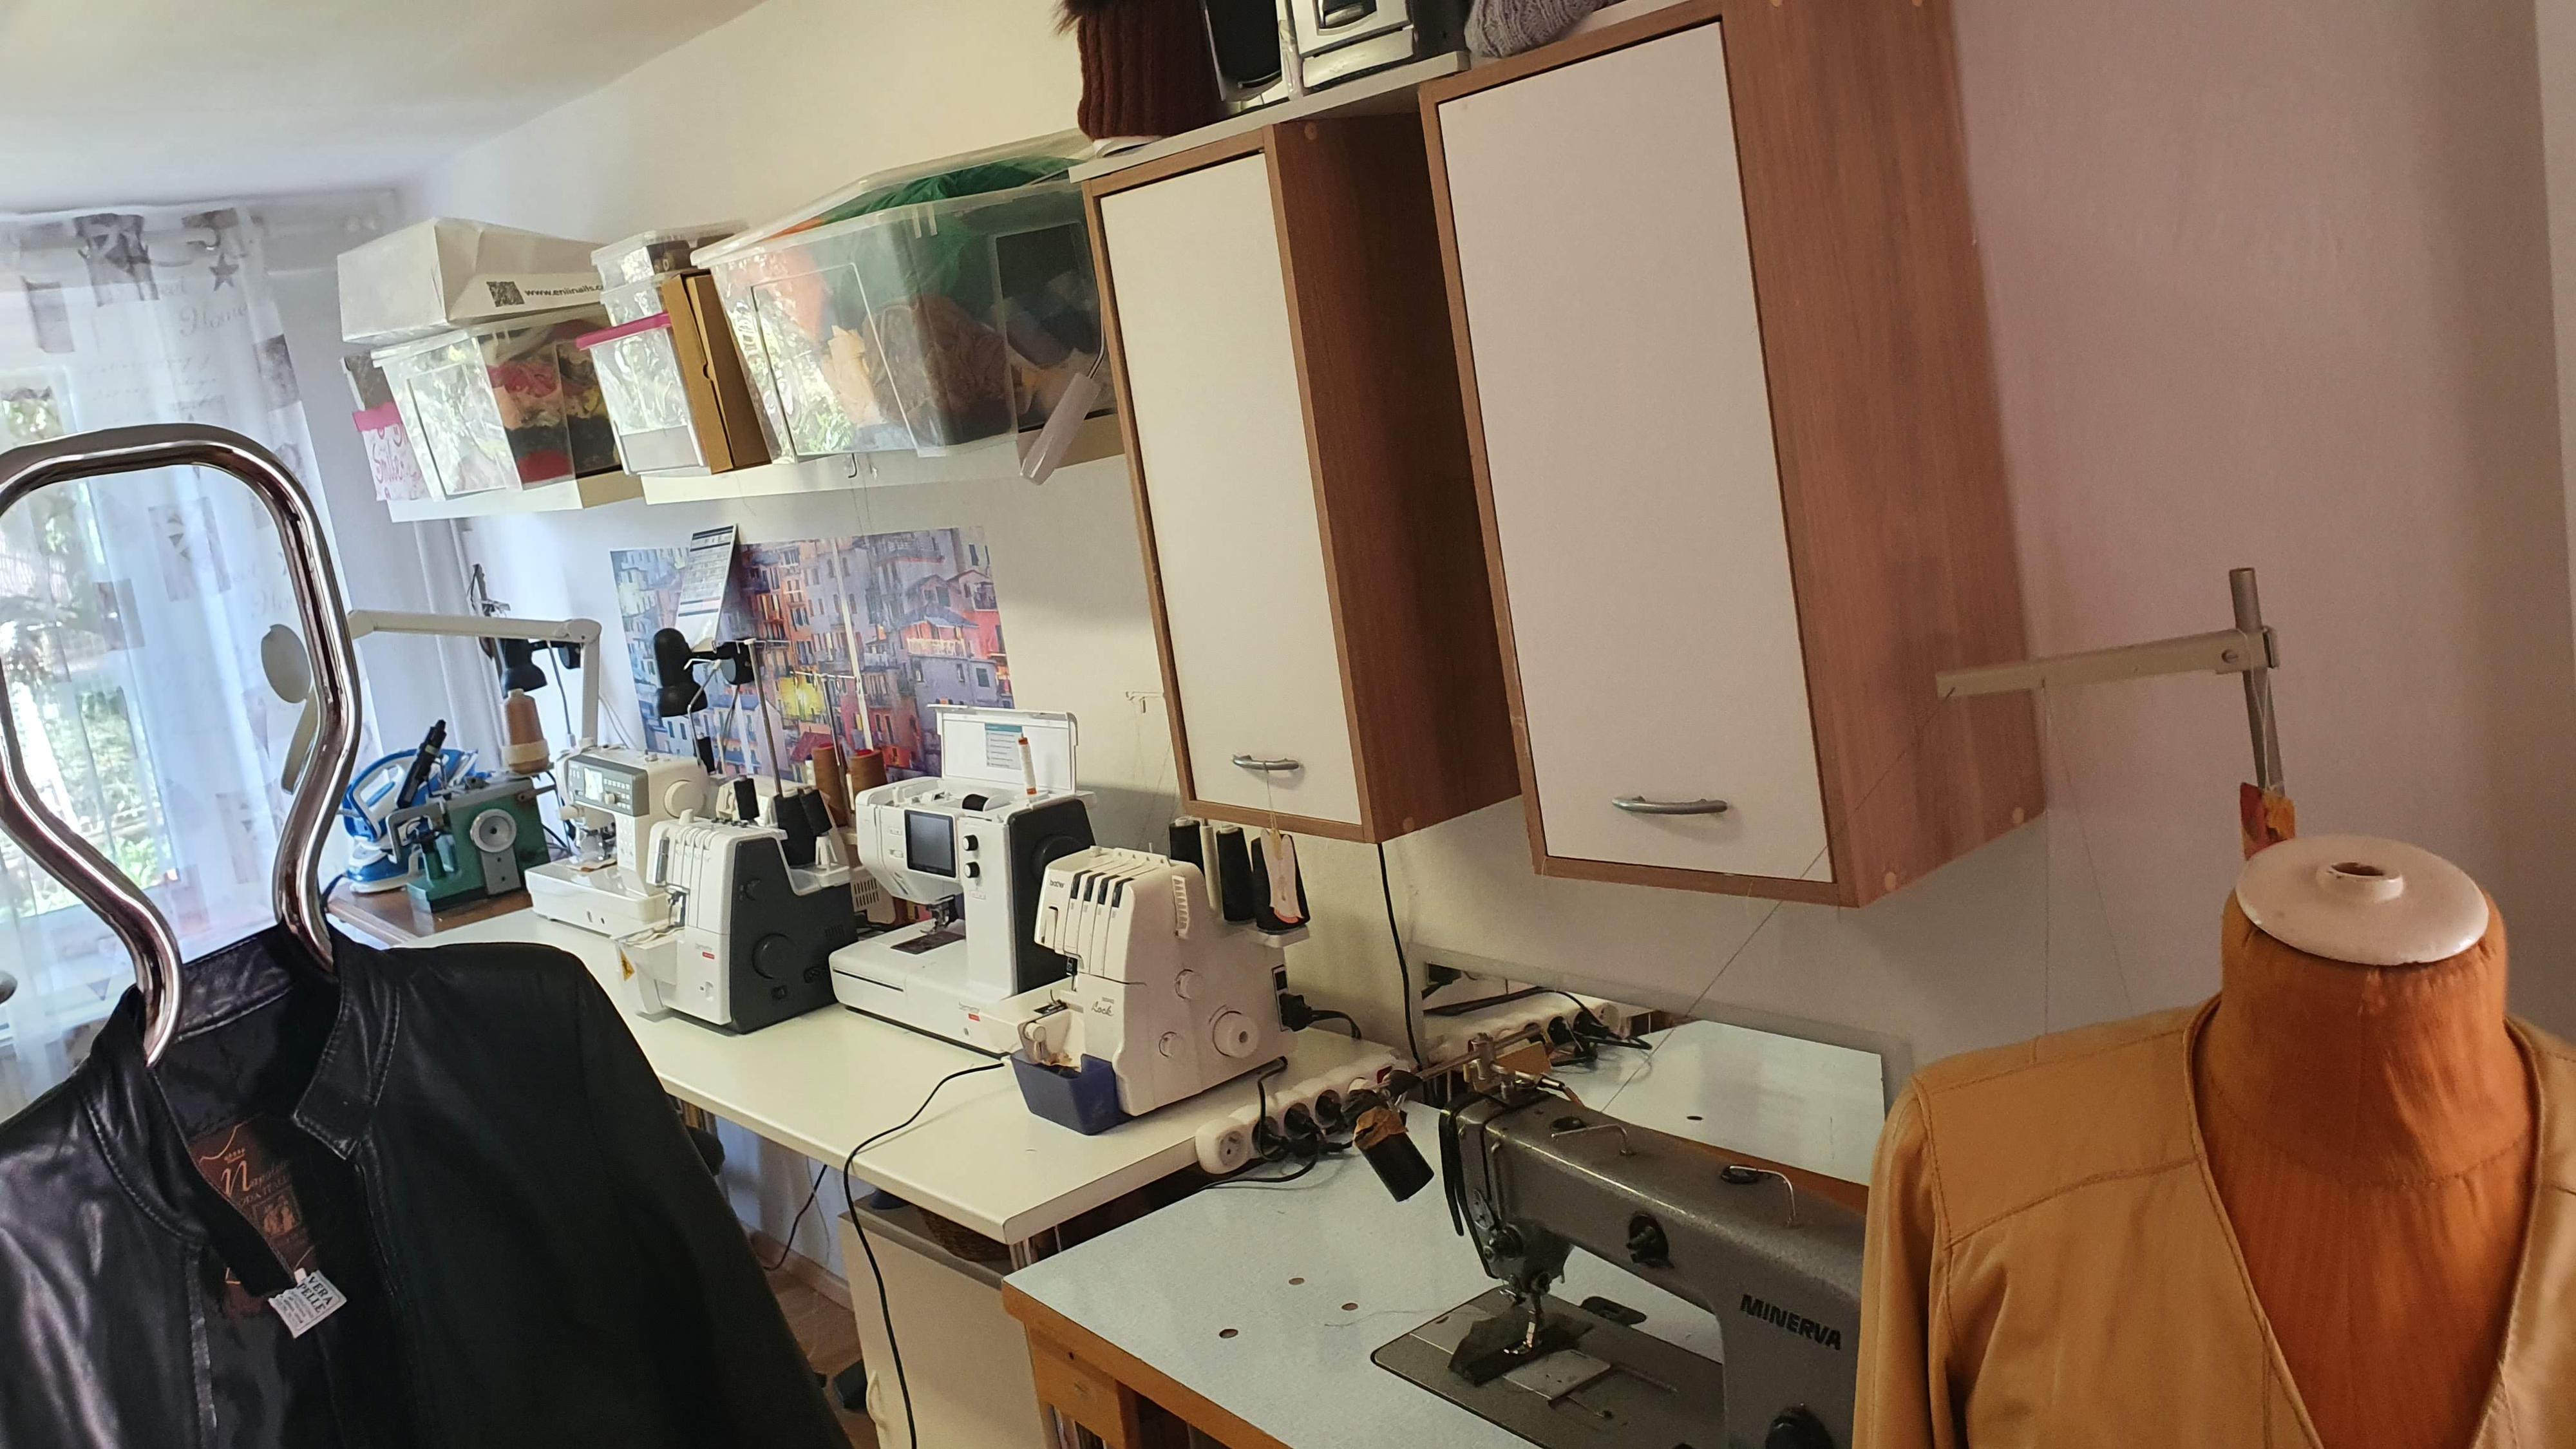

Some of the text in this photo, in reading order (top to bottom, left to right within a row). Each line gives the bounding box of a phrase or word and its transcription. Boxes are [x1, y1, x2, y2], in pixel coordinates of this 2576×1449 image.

[296, 1282, 327, 1315] PELLE
[308, 1276, 334, 1307] VERA
[1740, 1294, 1841, 1350] MINERVA
